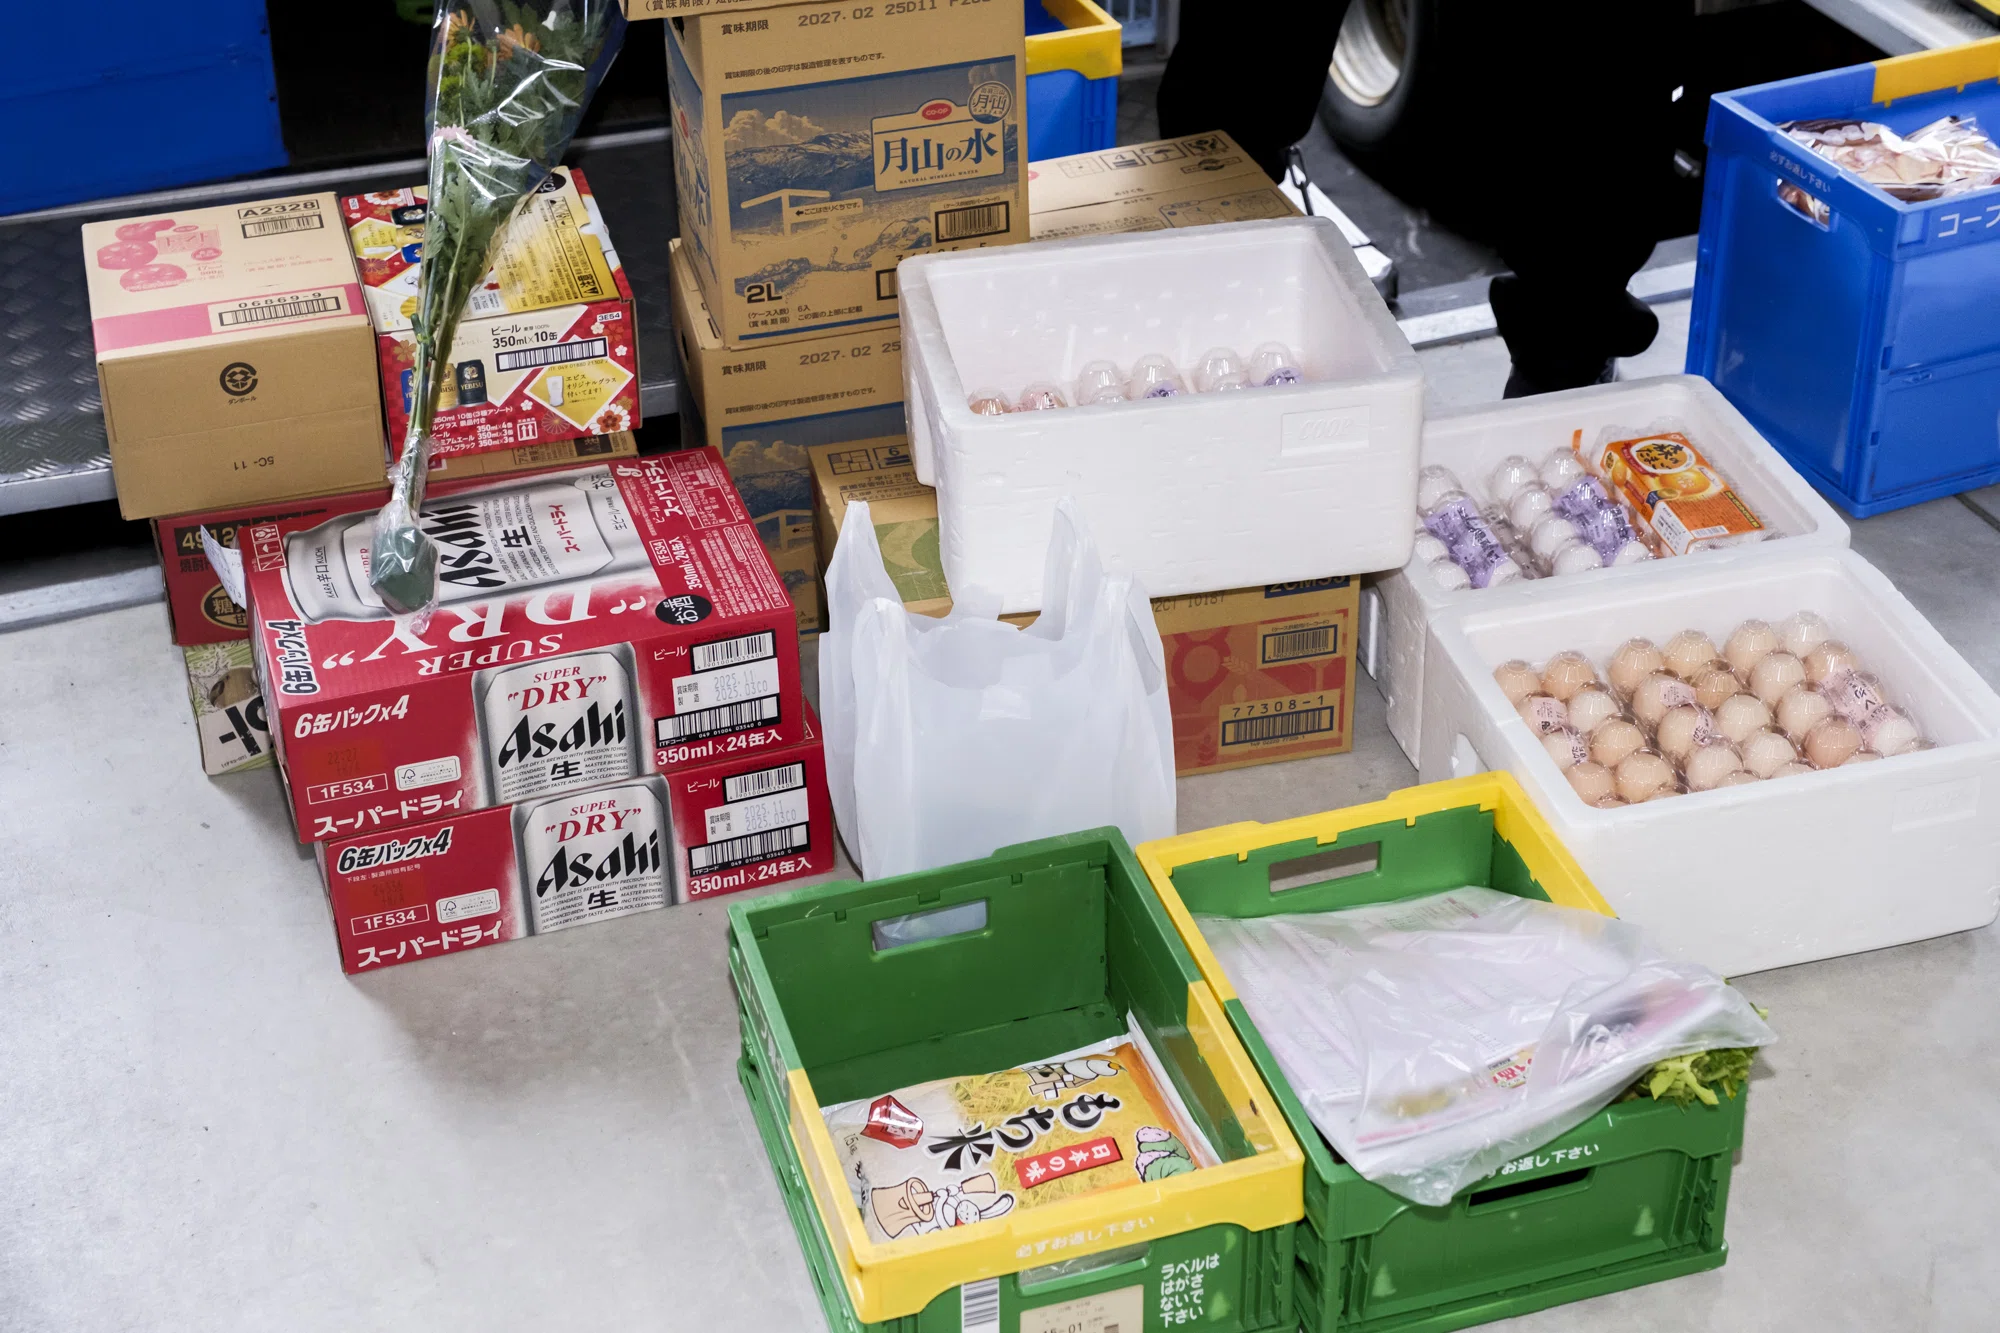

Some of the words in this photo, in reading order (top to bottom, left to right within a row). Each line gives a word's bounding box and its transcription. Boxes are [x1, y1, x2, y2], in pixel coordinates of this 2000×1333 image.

[721, 19, 769, 36] 賞味期限
[880, 128, 999, 175] 月山の水
[1768, 150, 1832, 194] 必ずお返し下さい
[242, 201, 316, 218] A2328
[804, 201, 861, 215] ここはきりくちです。
[238, 292, 322, 309] 06869-9
[746, 283, 783, 304] 2L
[491, 324, 522, 336] ビール
[721, 360, 767, 376] 賞味期限
[460, 380, 484, 391] YEBISU
[888, 447, 900, 456] 6
[640, 456, 683, 519] スーパードライ
[606, 505, 629, 532] 生ビール
[647, 504, 665, 524] ビール
[500, 525, 533, 548] 生
[548, 504, 582, 553] スーパードライ
[419, 503, 507, 588] Asahi
[651, 540, 671, 563] 1F534
[667, 594, 700, 625] お酒
[418, 633, 564, 676] SUPER
[653, 645, 688, 662] ビール
[533, 666, 581, 684] SUPER
[1232, 695, 1325, 719] 77308-1
[498, 698, 627, 769] Asahi
[550, 760, 583, 781] 生
[320, 778, 375, 800] 1F534
[687, 778, 720, 793] ビール
[313, 789, 464, 838] スーパードライ
[569, 799, 617, 817] SUPER
[535, 827, 661, 899] Asahi
[587, 889, 619, 911] 生
[363, 911, 417, 931] 1F534
[357, 920, 503, 968] スーパードライ
[927, 1093, 1121, 1172] もち米
[1023, 1144, 1112, 1182] 日本の味
[1015, 1215, 1155, 1259] 必ずお返し下さい
[1160, 1252, 1220, 1280] ラベルは
[1160, 1273, 1204, 1297] はがさ
[1160, 1289, 1204, 1312] ないで
[1159, 1308, 1204, 1329] 下さい
